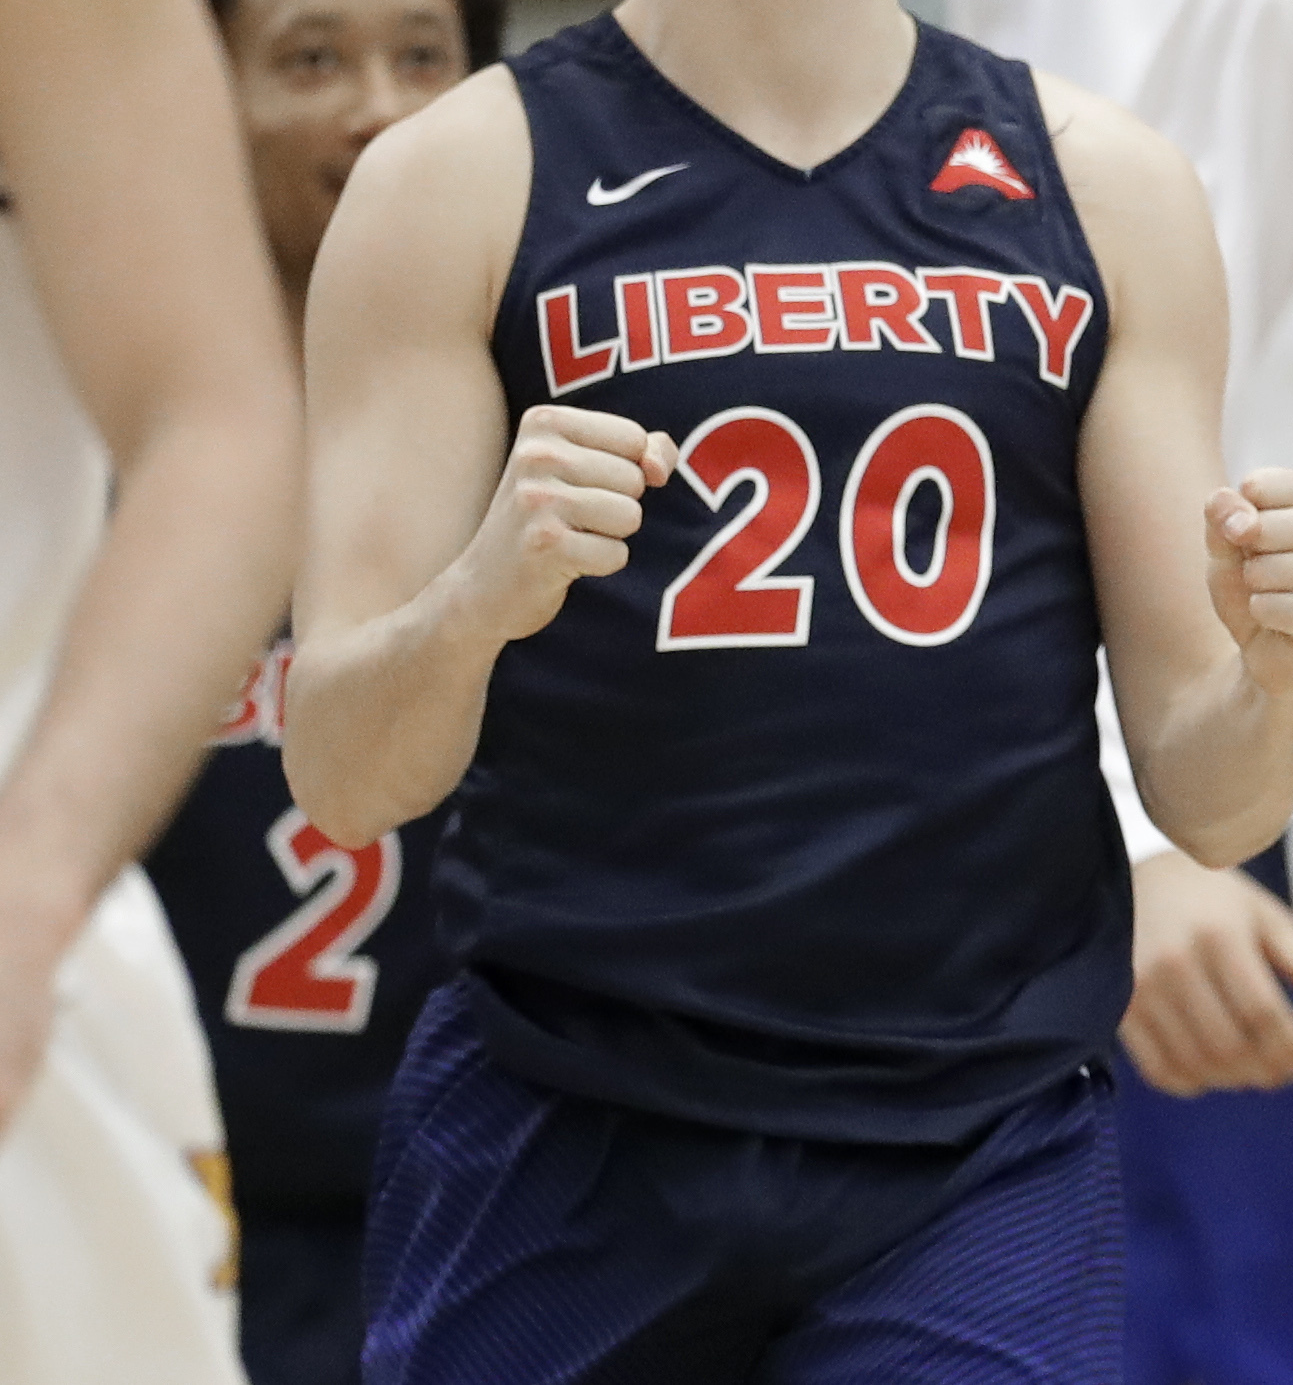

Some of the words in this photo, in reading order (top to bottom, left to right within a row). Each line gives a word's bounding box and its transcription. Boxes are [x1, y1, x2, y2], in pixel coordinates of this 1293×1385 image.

[535, 260, 1094, 399] LIBERTY
[655, 402, 997, 653] 20
[224, 806, 403, 1034] 2
